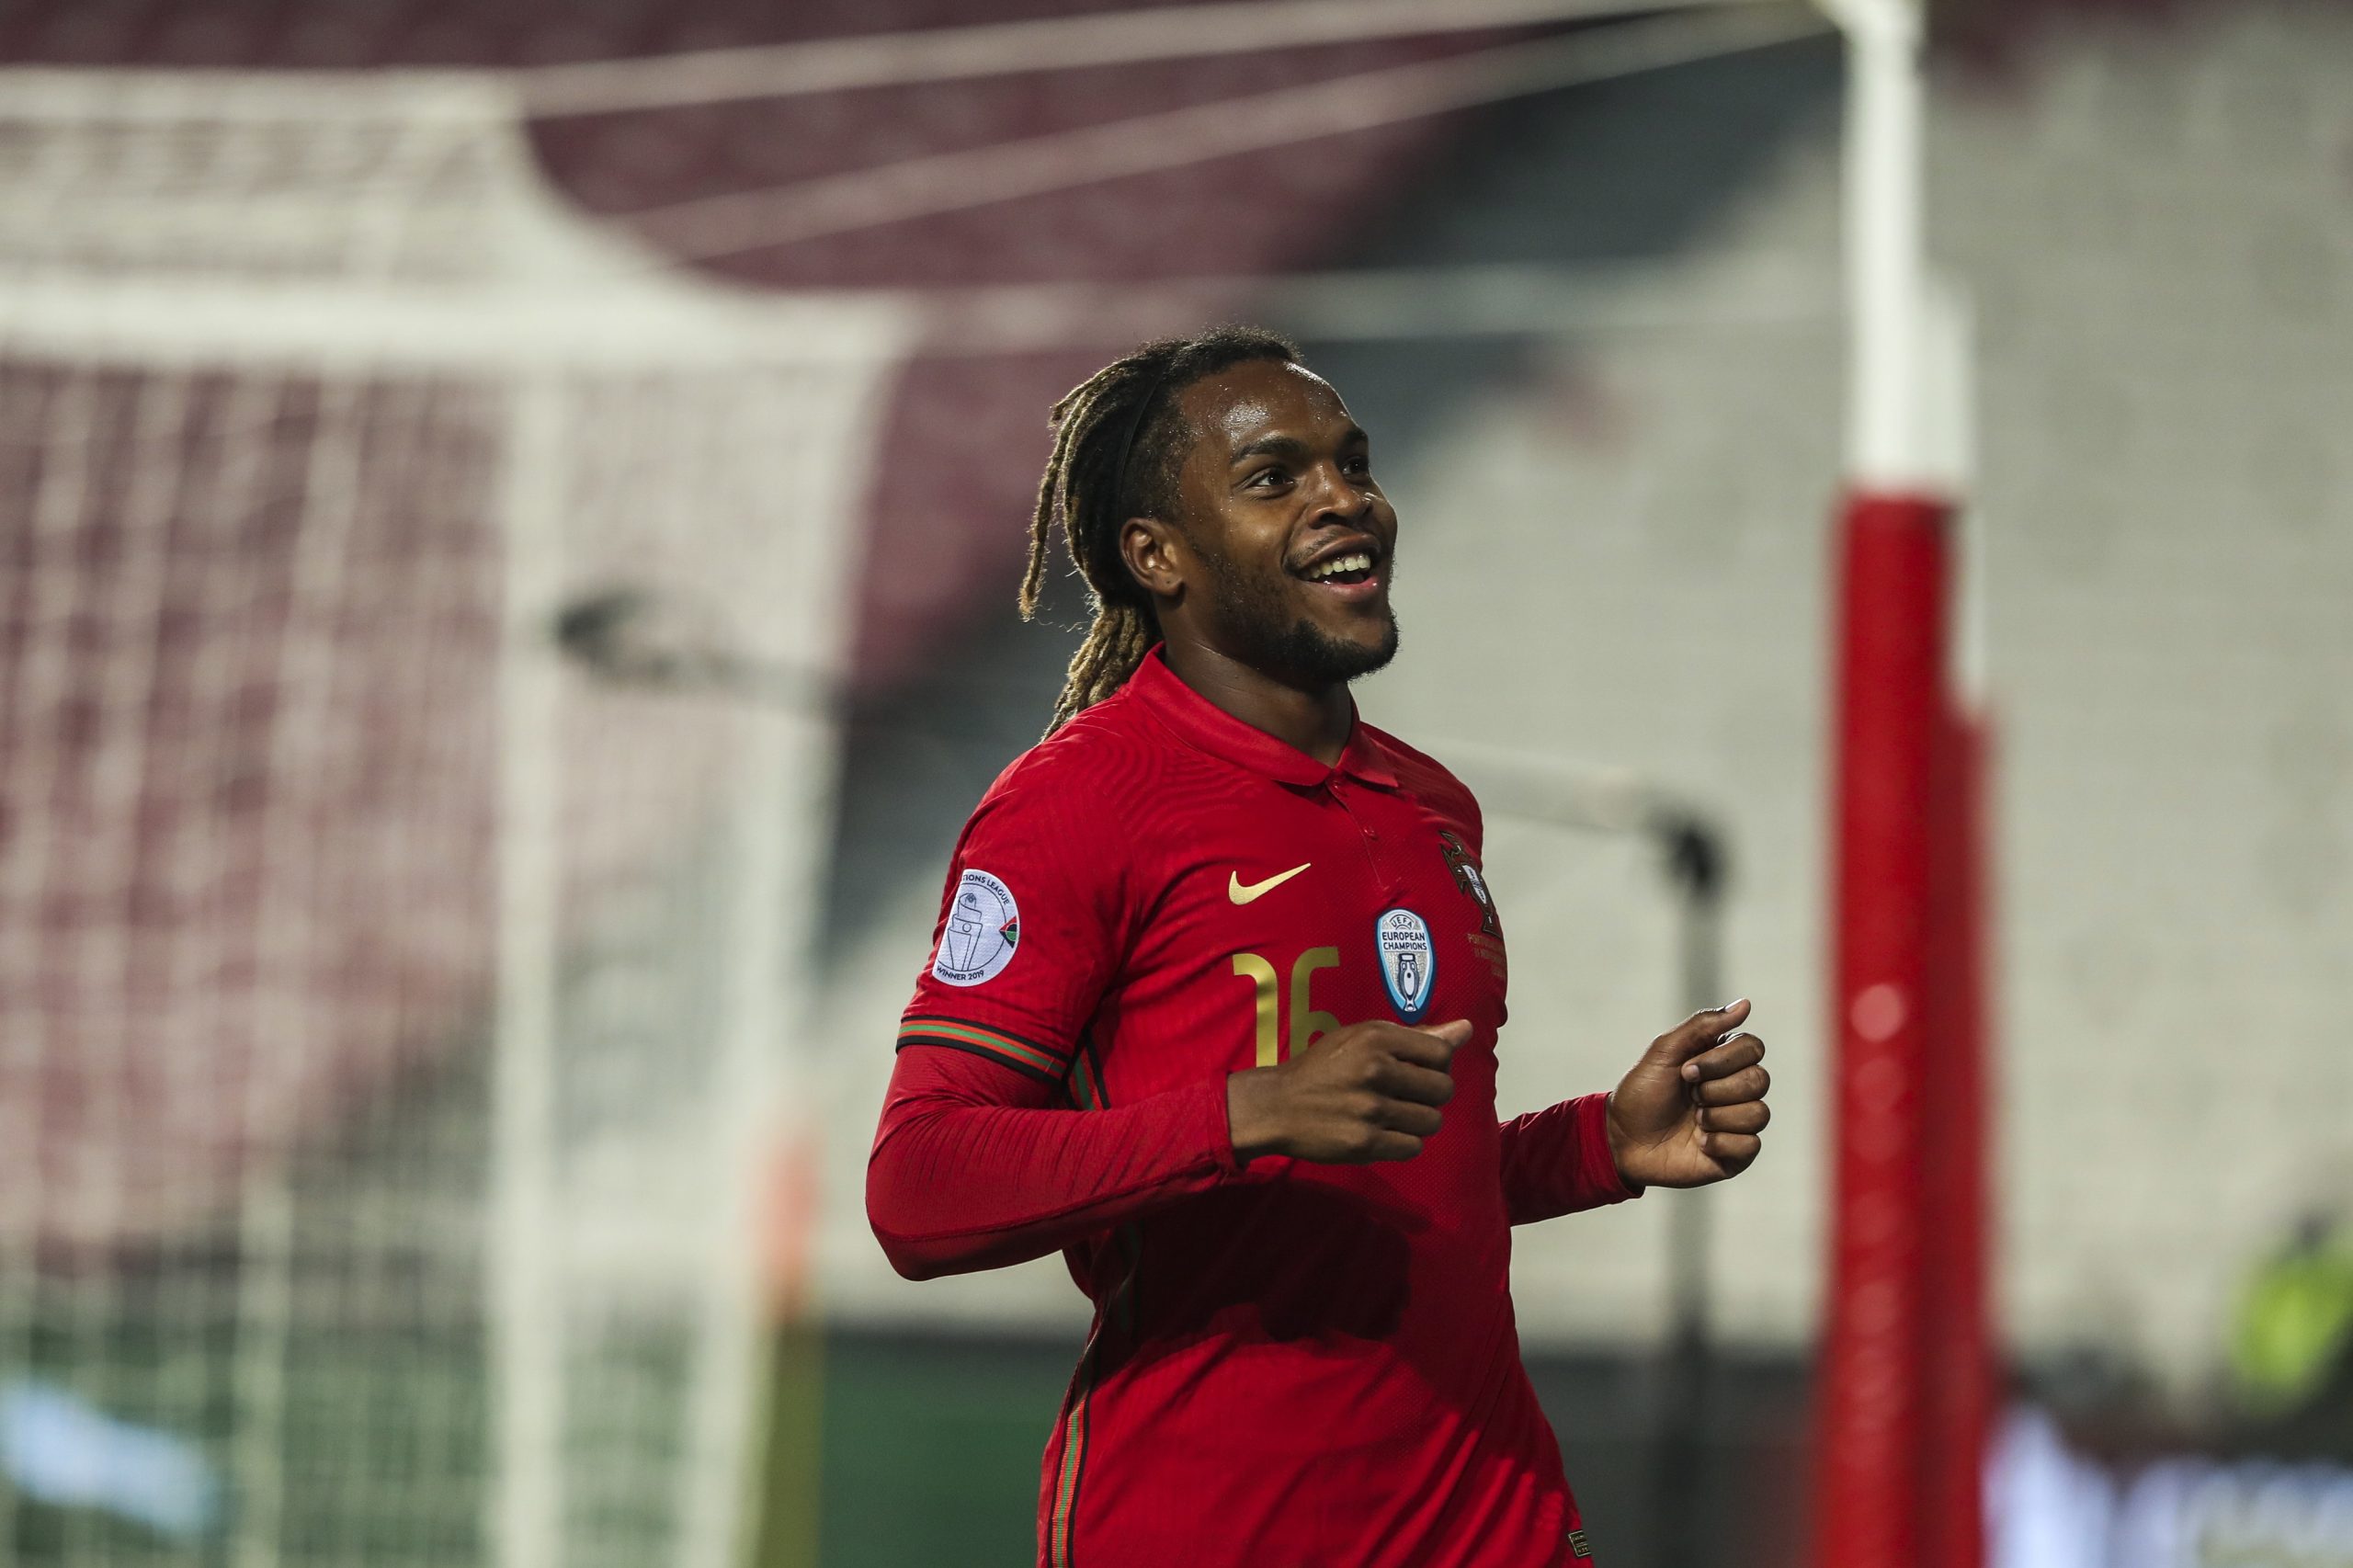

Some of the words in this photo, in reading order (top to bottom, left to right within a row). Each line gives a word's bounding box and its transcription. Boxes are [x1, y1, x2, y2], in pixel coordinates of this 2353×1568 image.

[986, 880, 1010, 905] LEAGUE
[1391, 916, 1413, 928] UEFA
[1381, 931, 1426, 941] EUROPEAN
[1382, 942, 1427, 950] CHAMPIONS
[937, 965, 966, 981] WINNER
[968, 970, 984, 981] 2019
[1233, 947, 1340, 1067] 16
